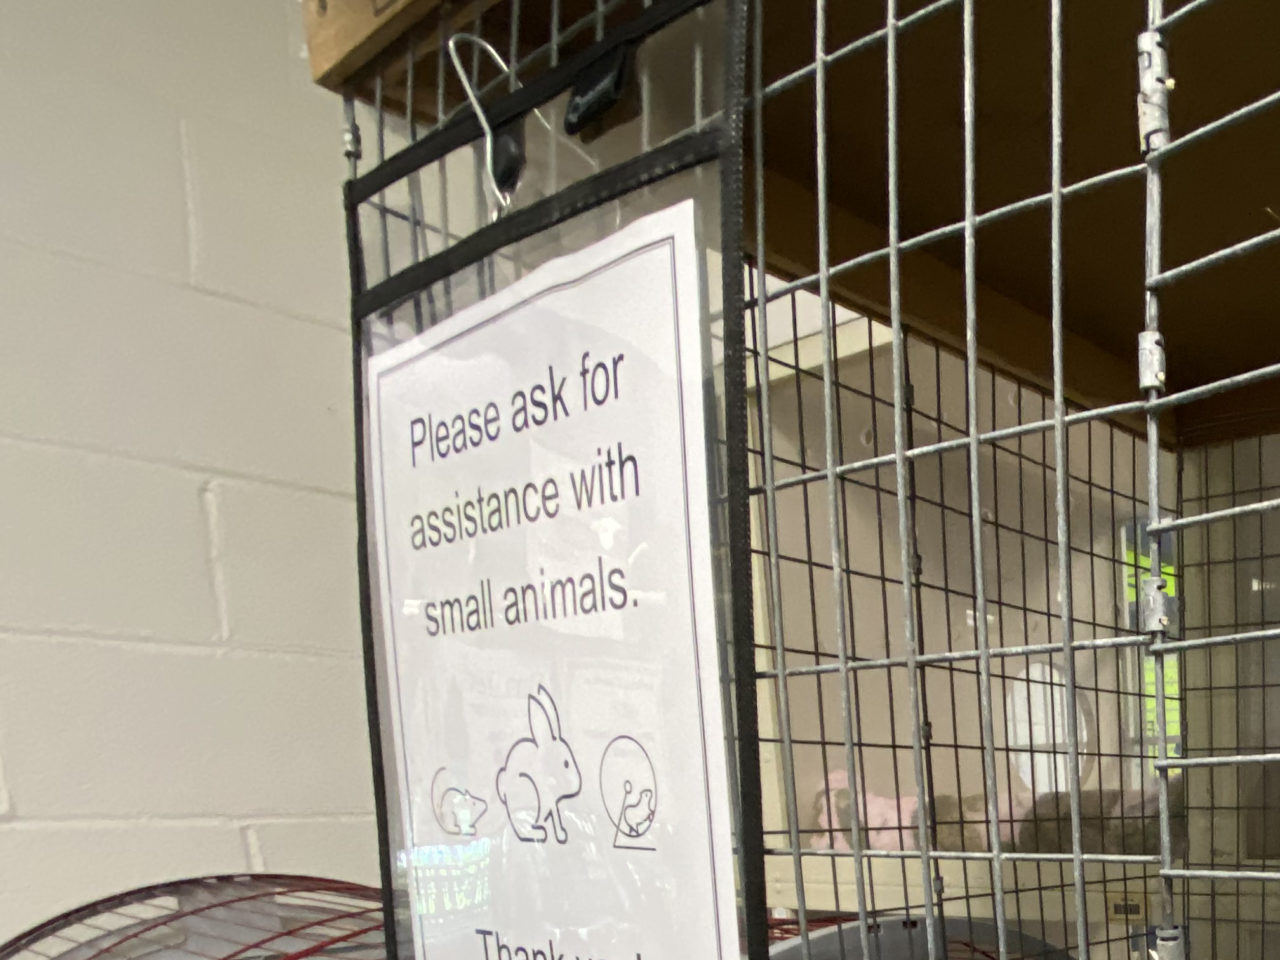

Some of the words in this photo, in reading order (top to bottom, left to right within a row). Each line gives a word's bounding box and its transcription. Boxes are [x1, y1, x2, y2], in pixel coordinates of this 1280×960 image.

[410, 402, 501, 467] Please
[511, 366, 570, 432] ask
[579, 351, 625, 411] for
[410, 477, 560, 551] assistance
[570, 441, 640, 511] with
[425, 578, 495, 637] small
[504, 556, 639, 625] animals.
